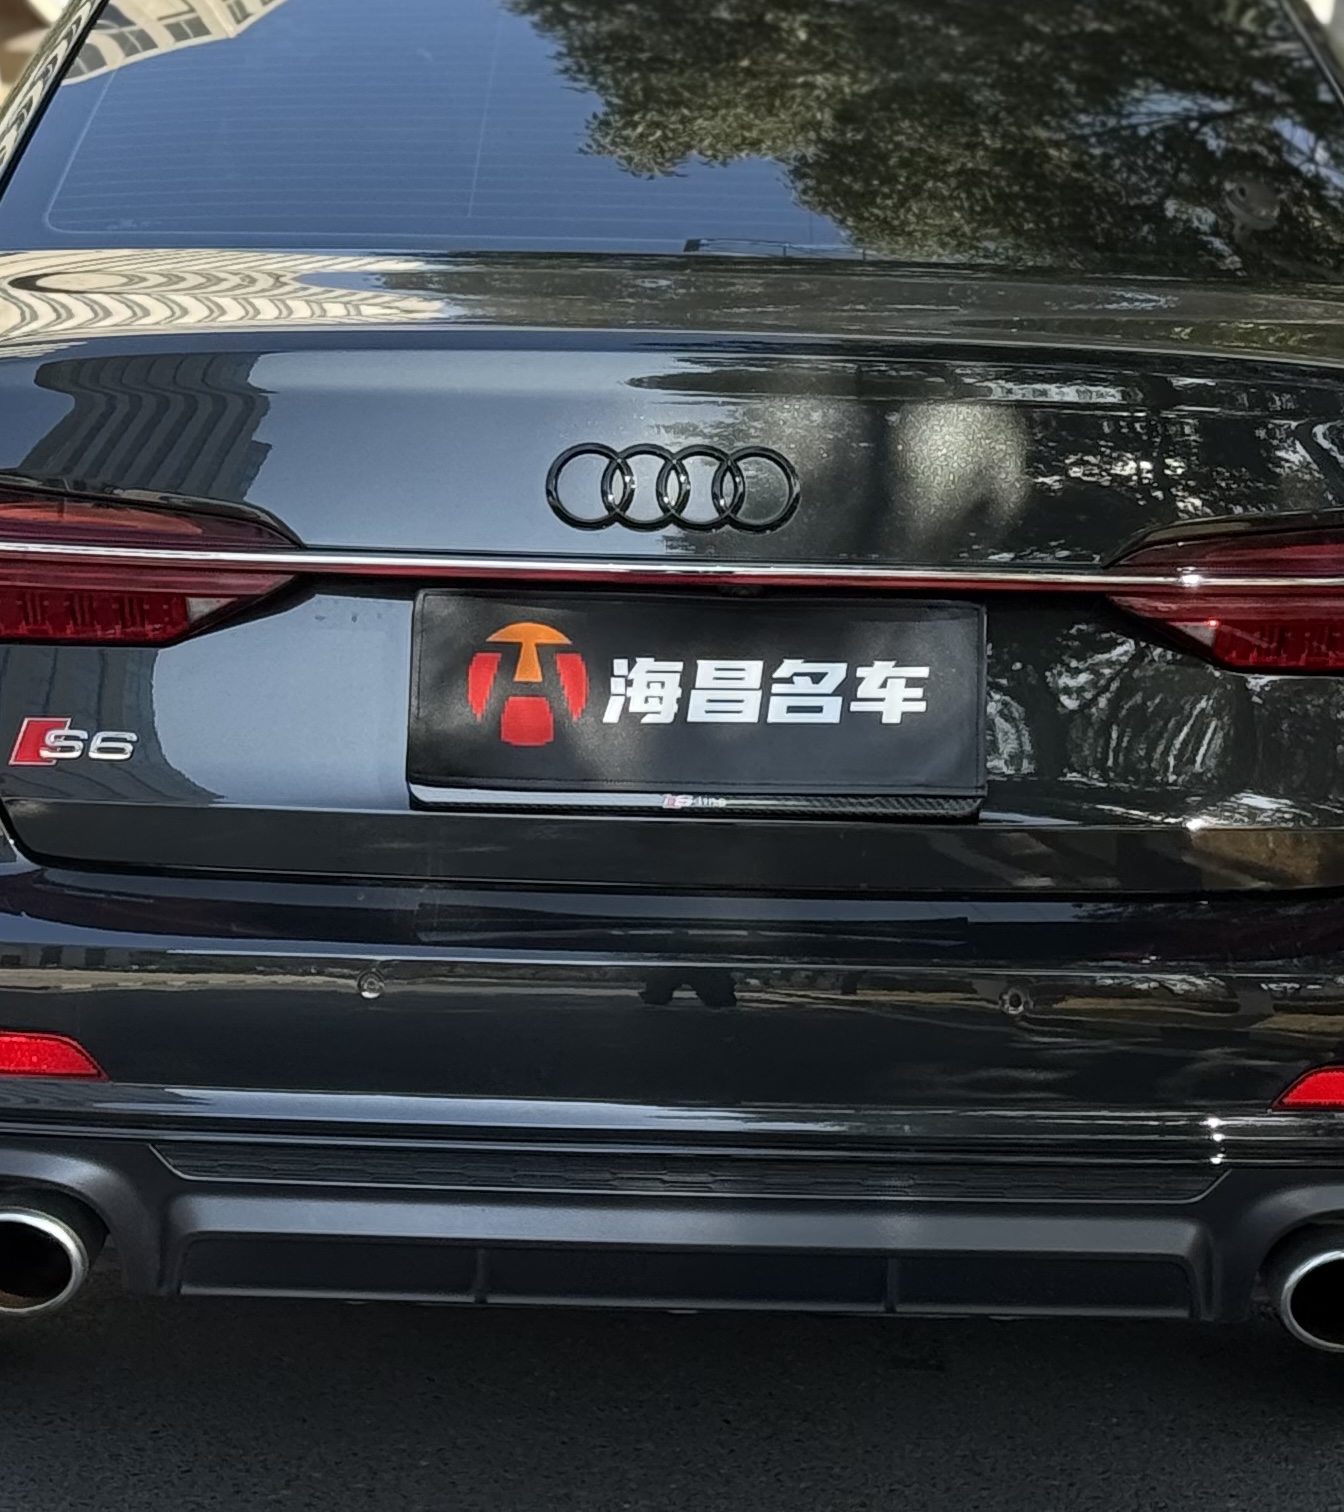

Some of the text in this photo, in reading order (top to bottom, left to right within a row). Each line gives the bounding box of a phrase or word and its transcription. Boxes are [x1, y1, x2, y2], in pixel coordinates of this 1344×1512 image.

[602, 656, 931, 725] 海昌名车
[38, 728, 139, 761] S6
